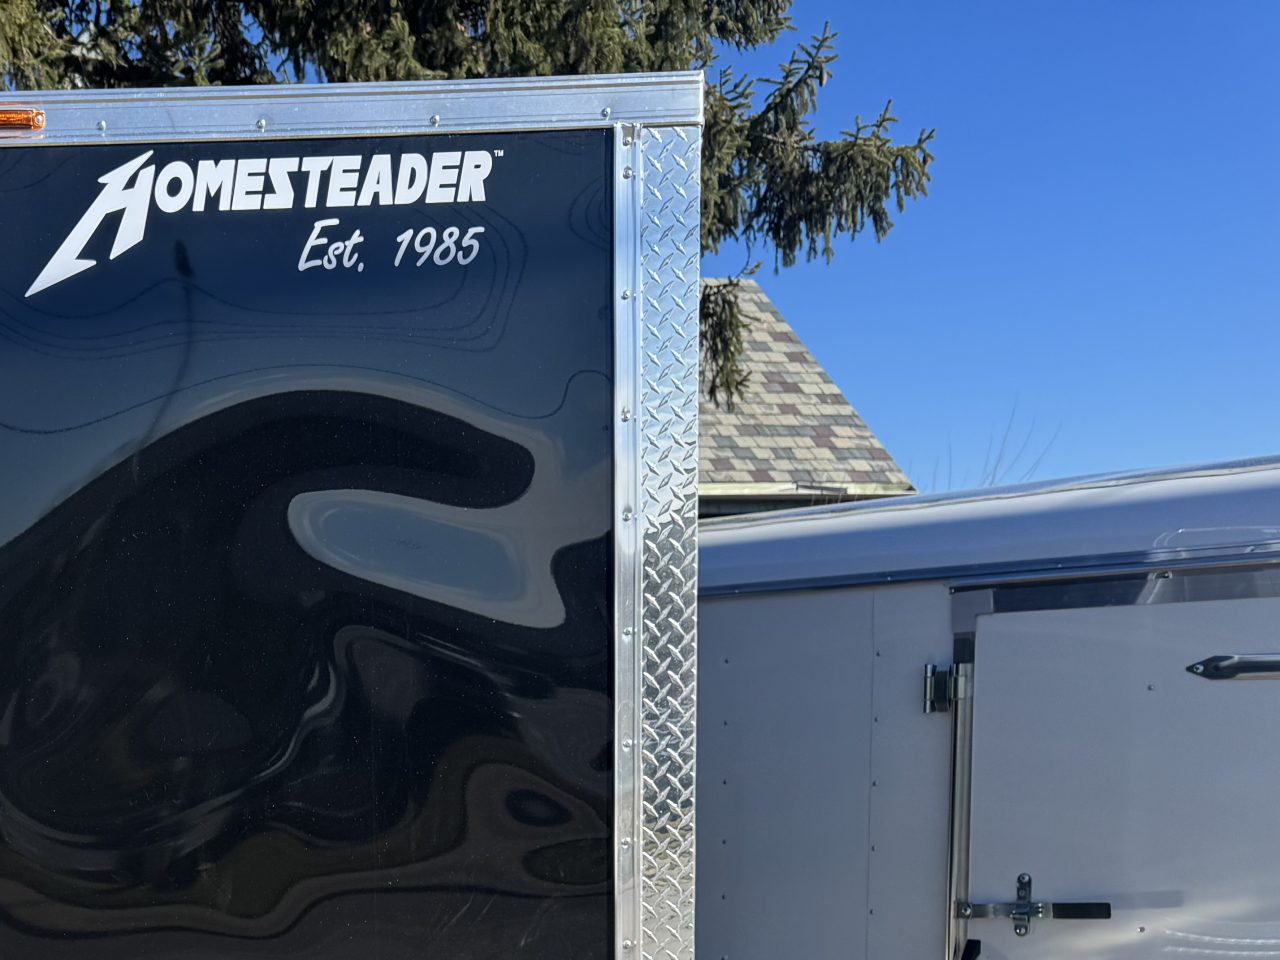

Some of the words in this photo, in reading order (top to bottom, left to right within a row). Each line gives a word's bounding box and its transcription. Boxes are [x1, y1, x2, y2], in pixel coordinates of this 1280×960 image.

[24, 150, 493, 297] HOMESTEADER
[297, 218, 365, 272] Est.
[394, 226, 486, 268] 1985
